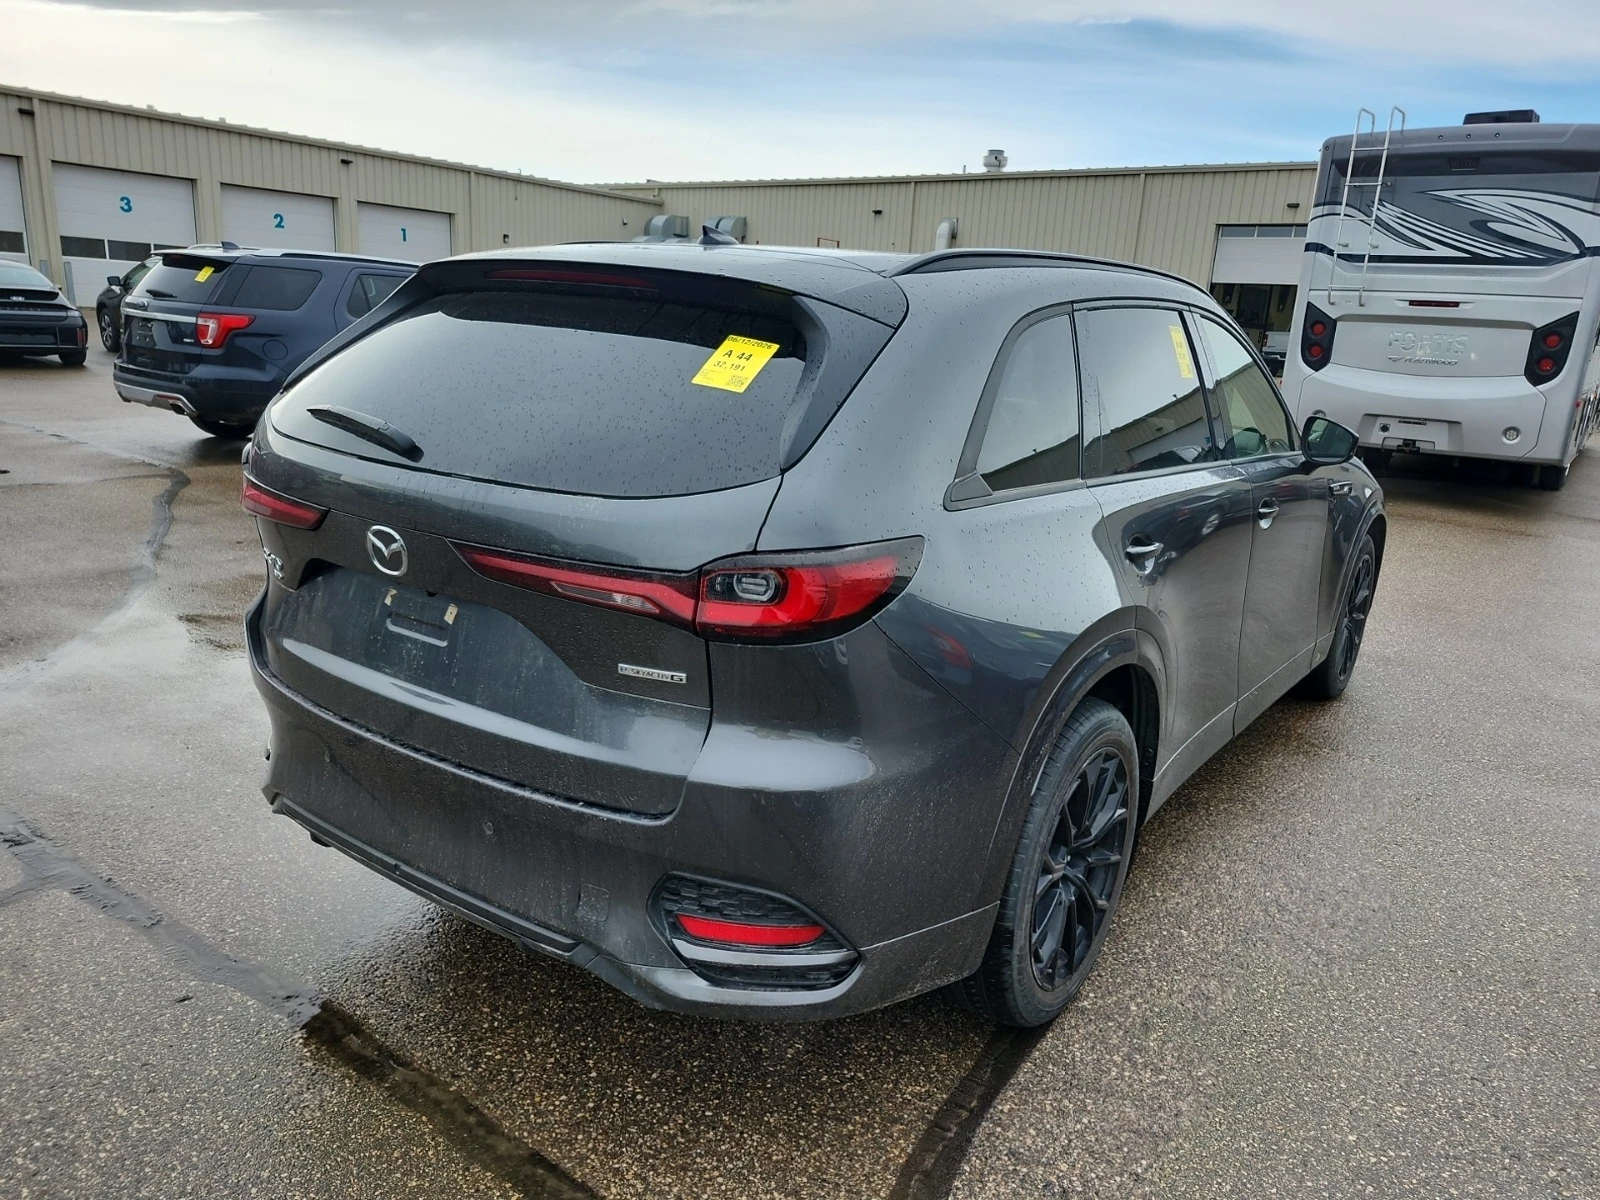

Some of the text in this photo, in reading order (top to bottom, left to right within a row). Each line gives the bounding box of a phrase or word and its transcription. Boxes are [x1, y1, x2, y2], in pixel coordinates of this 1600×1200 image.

[120, 196, 132, 212] 3
[273, 213, 285, 228] 2
[401, 227, 407, 241] 1
[727, 336, 773, 350] 06/12/2026
[1388, 331, 1468, 355] FORTIS
[723, 349, 753, 361] A 44
